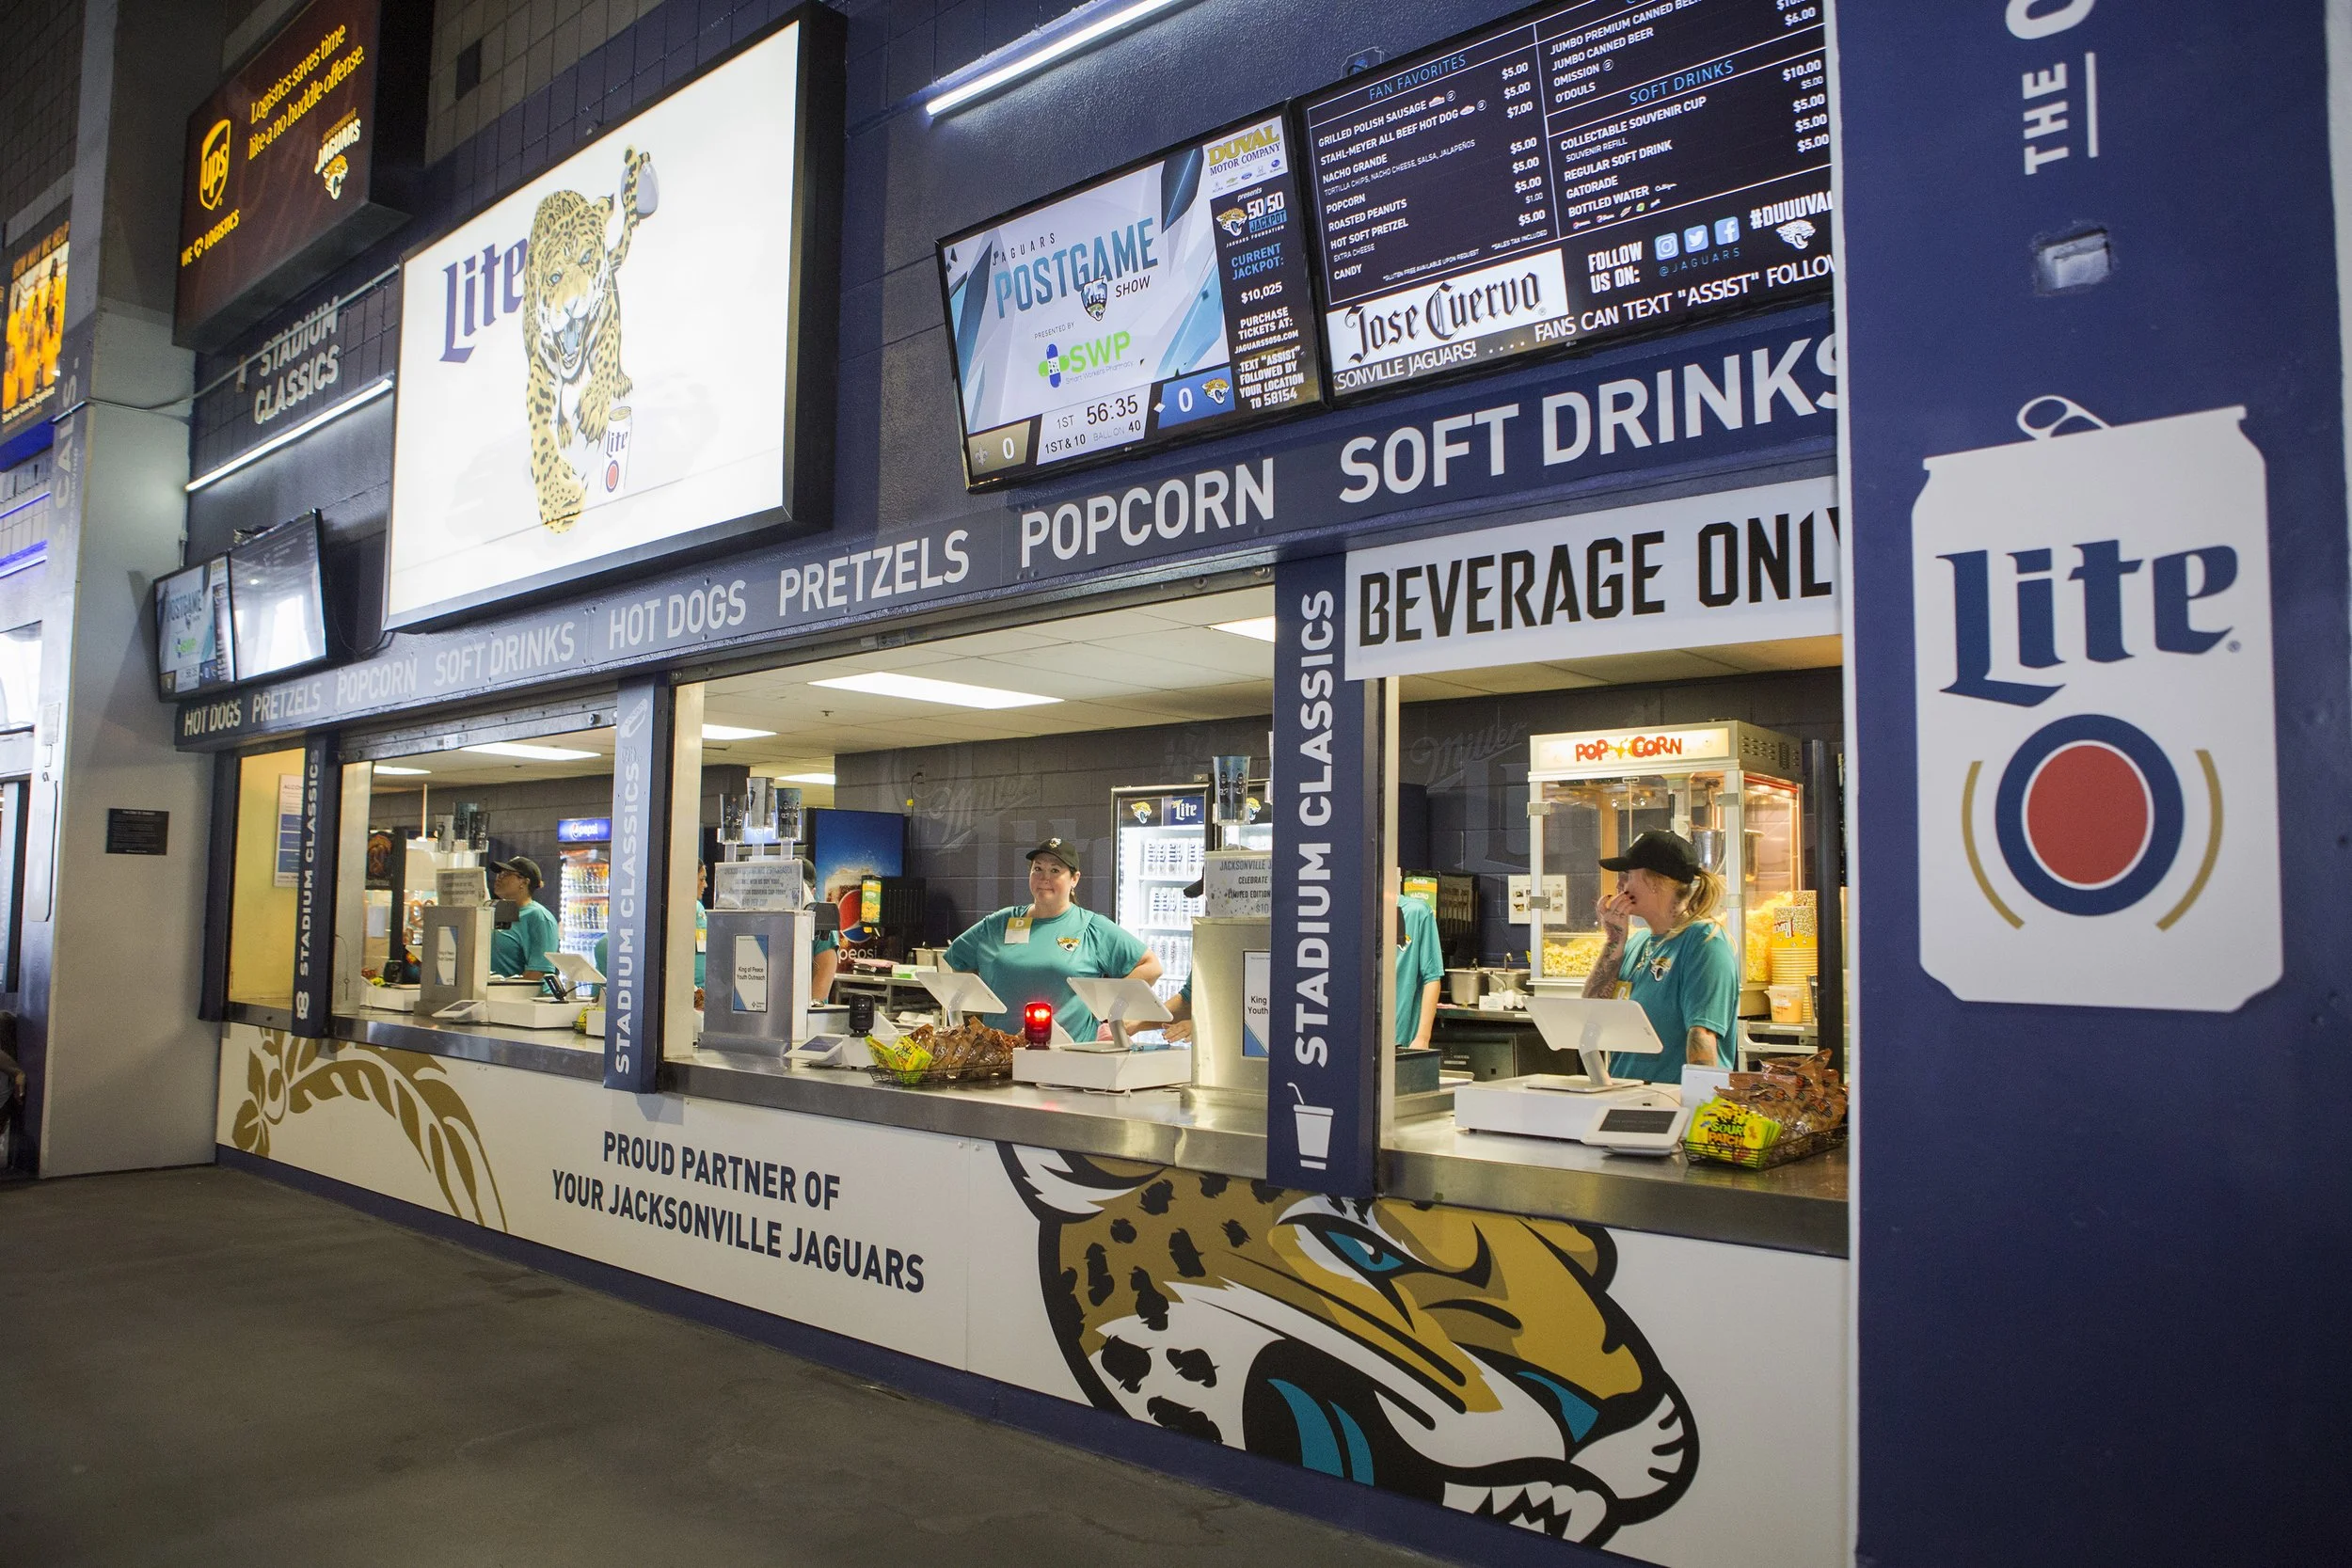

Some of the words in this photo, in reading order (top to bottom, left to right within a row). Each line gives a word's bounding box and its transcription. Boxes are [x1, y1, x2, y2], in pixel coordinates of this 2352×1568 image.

[1550, 35, 1584, 55] JUMBO
[1584, 17, 1631, 43] PREMIUM
[1632, 2, 1674, 24] CANNED
[1552, 51, 1585, 71] JUMBO
[1586, 36, 1627, 58] CANNED
[1628, 26, 1654, 45] BEER
[1784, 7, 1816, 27] $6.00
[247, 133, 266, 160] like
[266, 127, 273, 145] a
[273, 114, 287, 136] no
[287, 79, 324, 128] huddle
[324, 45, 365, 94] offense.
[250, 73, 292, 125] Logistics
[292, 48, 320, 87] saves
[320, 24, 346, 60] time
[1369, 82, 1392, 101] FAN
[1397, 54, 1466, 90] FAVORITES
[1553, 63, 1599, 87] OMISSION
[1555, 81, 1597, 103] O'DOULS
[1629, 81, 1668, 105] SOFT
[1673, 60, 1734, 91] DRINKS
[1318, 128, 1353, 148] GRILLED
[1354, 116, 1385, 135] POLISH
[1386, 100, 1427, 123] SAUSAGE
[1502, 61, 1529, 81] $5.00
[1320, 137, 1377, 166] STAHL-MEYER
[1378, 132, 1395, 146] ALL
[1396, 122, 1418, 140] BEEF
[1419, 116, 1438, 132] HOT
[1439, 108, 1459, 124] DOG
[1503, 81, 1532, 101] $5.00
[1560, 120, 1629, 150] COLLECTABLE
[1629, 104, 1682, 130] SOUVENIR
[1683, 96, 1708, 112] CUP
[1782, 59, 1822, 82] $10.00
[1565, 146, 1601, 163] SOUVENIR
[1602, 137, 1629, 151] REFILL
[1801, 75, 1824, 90] $5.00
[2022, 62, 2070, 176] THE
[313, 118, 361, 175] JAGUARS
[1208, 124, 1281, 166] DUVAL
[1209, 157, 1240, 177] MOTOR
[1242, 142, 1281, 165] COMPANY
[1322, 166, 1352, 184] NACHO
[1353, 153, 1389, 174] GRANDE
[1506, 101, 1534, 119] $7.00
[1564, 159, 1611, 182] REGULAR
[1611, 150, 1638, 167] SOFT
[1639, 139, 1673, 160] DRINK
[1792, 93, 1826, 114] $5.00
[1565, 175, 1618, 199] GATORADE
[1795, 113, 1828, 134] $5.00
[202, 143, 228, 198] ups
[1237, 186, 1263, 203] presents
[1326, 193, 1366, 214] POPCORN
[1510, 136, 1537, 155] $5.00
[1328, 211, 1366, 232] ROASTED
[1367, 198, 1408, 220] PEANUTS
[1512, 156, 1540, 174] $5.00
[1567, 197, 1613, 218] BOTTLED
[1613, 185, 1650, 205] WATER
[1797, 134, 1830, 153] $5.00
[1247, 191, 1285, 221] 50/50
[1249, 211, 1286, 233] JACKPOT
[1330, 236, 1347, 250] HOT
[1349, 229, 1371, 245] SOFT
[1372, 217, 1409, 238] PRETZEL
[1515, 176, 1542, 194] $5.00
[1333, 250, 1352, 263] EXTRA
[1353, 243, 1375, 257] CHEESE
[1525, 192, 1544, 204] $1.00
[992, 232, 1056, 266] JAGUARS
[993, 217, 1158, 320] POSTGAME
[1231, 243, 1282, 268] CURRENT
[1232, 256, 1284, 280] JACKPOT:
[1334, 263, 1362, 280] CANDY
[1518, 209, 1546, 227] $5.00
[1588, 241, 1643, 274] FOLLOW
[1659, 247, 1740, 277] @JAGUARS
[438, 237, 529, 364] Lite
[1115, 275, 1151, 298] SHOW
[1240, 281, 1283, 305] $10,025
[1590, 271, 1613, 294] US
[1613, 267, 1641, 290] ON:
[259, 295, 339, 377] STADIUM
[1238, 321, 1276, 341] TICKETS
[1278, 316, 1294, 331] AT:
[1239, 306, 1289, 329] PURCHASE
[1344, 304, 1422, 364] Jose
[1425, 271, 1543, 341] Cuervo
[1408, 341, 1477, 377] JAGUARS!
[1534, 315, 1577, 344] FANS
[1581, 306, 1619, 331] CAN
[1623, 292, 1673, 322] TEXT
[1767, 254, 1835, 288] FOLLO
[1069, 330, 1131, 373] SWP
[1239, 363, 1283, 386] FOLLOWED
[1285, 360, 1298, 373] BY
[254, 344, 341, 425] CLASSICS
[1057, 414, 1074, 429] 1ST
[1087, 394, 1138, 425] 56:35
[1238, 382, 1263, 399] YOUR
[1264, 372, 1305, 392] LOCATION
[1249, 396, 1262, 410] TO
[1263, 387, 1298, 407] 58154
[605, 429, 628, 459] Lite
[1339, 403, 1519, 504] SOFT
[1022, 457, 1274, 568] POPCORN
[779, 530, 970, 617] PRETZELS
[1359, 531, 1665, 647] BEVERAGE
[1698, 506, 1840, 608] ONL
[609, 597, 660, 651] HOT
[667, 579, 747, 640] DOGS
[1935, 538, 2239, 708] Lite
[336, 656, 419, 707] POPCORN
[433, 643, 487, 689] SOFT
[489, 621, 576, 676] DRINKS
[183, 708, 207, 737] HOT
[210, 698, 241, 730] DOGS
[252, 681, 322, 724] PRETZELS
[1298, 589, 1334, 827] CLASSICS
[1575, 739, 1609, 762] POP
[1631, 736, 1682, 758] CORN
[305, 749, 320, 863] CLASSICS
[580, 822, 598, 837] pepsi
[1175, 802, 1198, 821] Lite
[620, 761, 640, 916] CLASSICS
[1219, 860, 1265, 871] JACKSONVILLE
[299, 869, 313, 977] STADIUM
[838, 945, 877, 963] pepsi
[1295, 843, 1331, 1069] STADIUM
[615, 928, 634, 1076] STADIUM
[1248, 1006, 1269, 1015] Youth
[1250, 995, 1267, 1006] King
[1708, 1132, 1744, 1146] PATCH
[1710, 1121, 1744, 1134] SOUR
[602, 1131, 675, 1177] PROUD
[681, 1146, 796, 1204] PARTNER
[803, 1171, 841, 1212] OF
[552, 1168, 604, 1212] YOUR
[608, 1183, 782, 1259] JACKSONVILLE
[788, 1227, 925, 1294] JAGUARS
